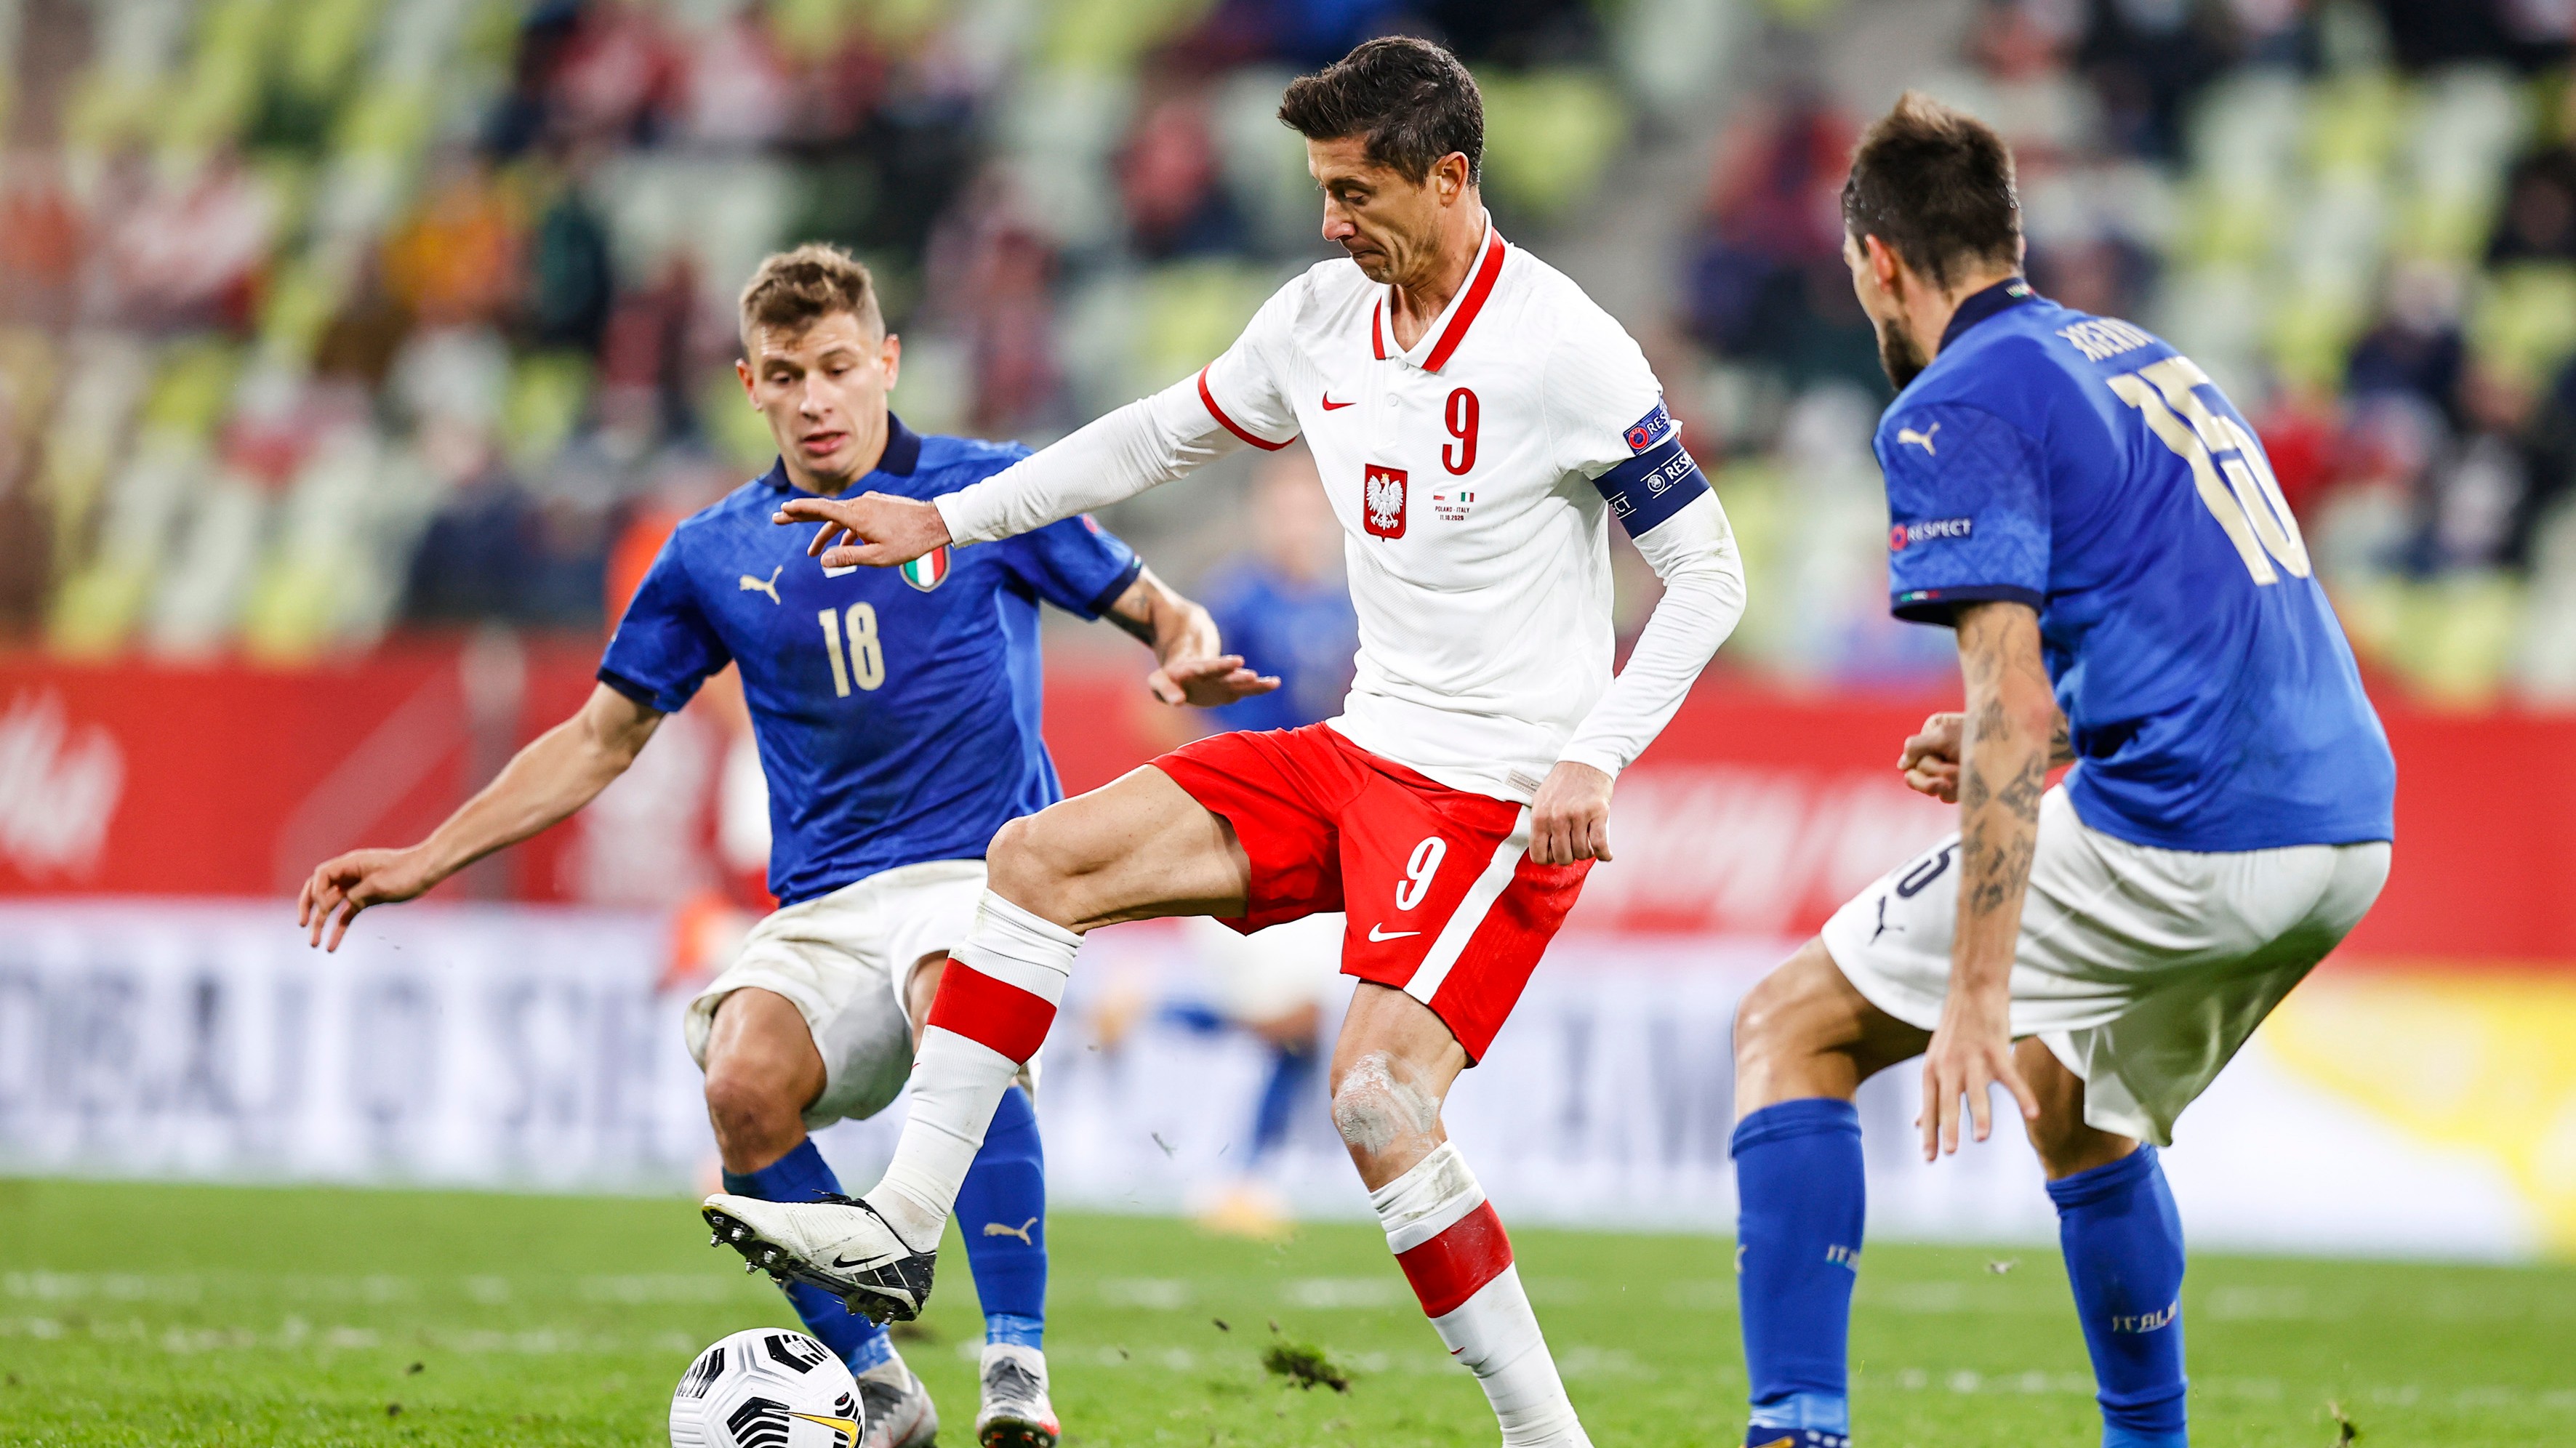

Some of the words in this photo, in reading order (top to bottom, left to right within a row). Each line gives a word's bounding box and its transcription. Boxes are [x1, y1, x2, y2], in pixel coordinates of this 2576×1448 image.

[1442, 387, 1480, 476] 9
[2106, 355, 2311, 586] 15
[1907, 518, 1971, 541] RESPECT
[818, 600, 886, 698] 18
[1395, 835, 1447, 911] 9
